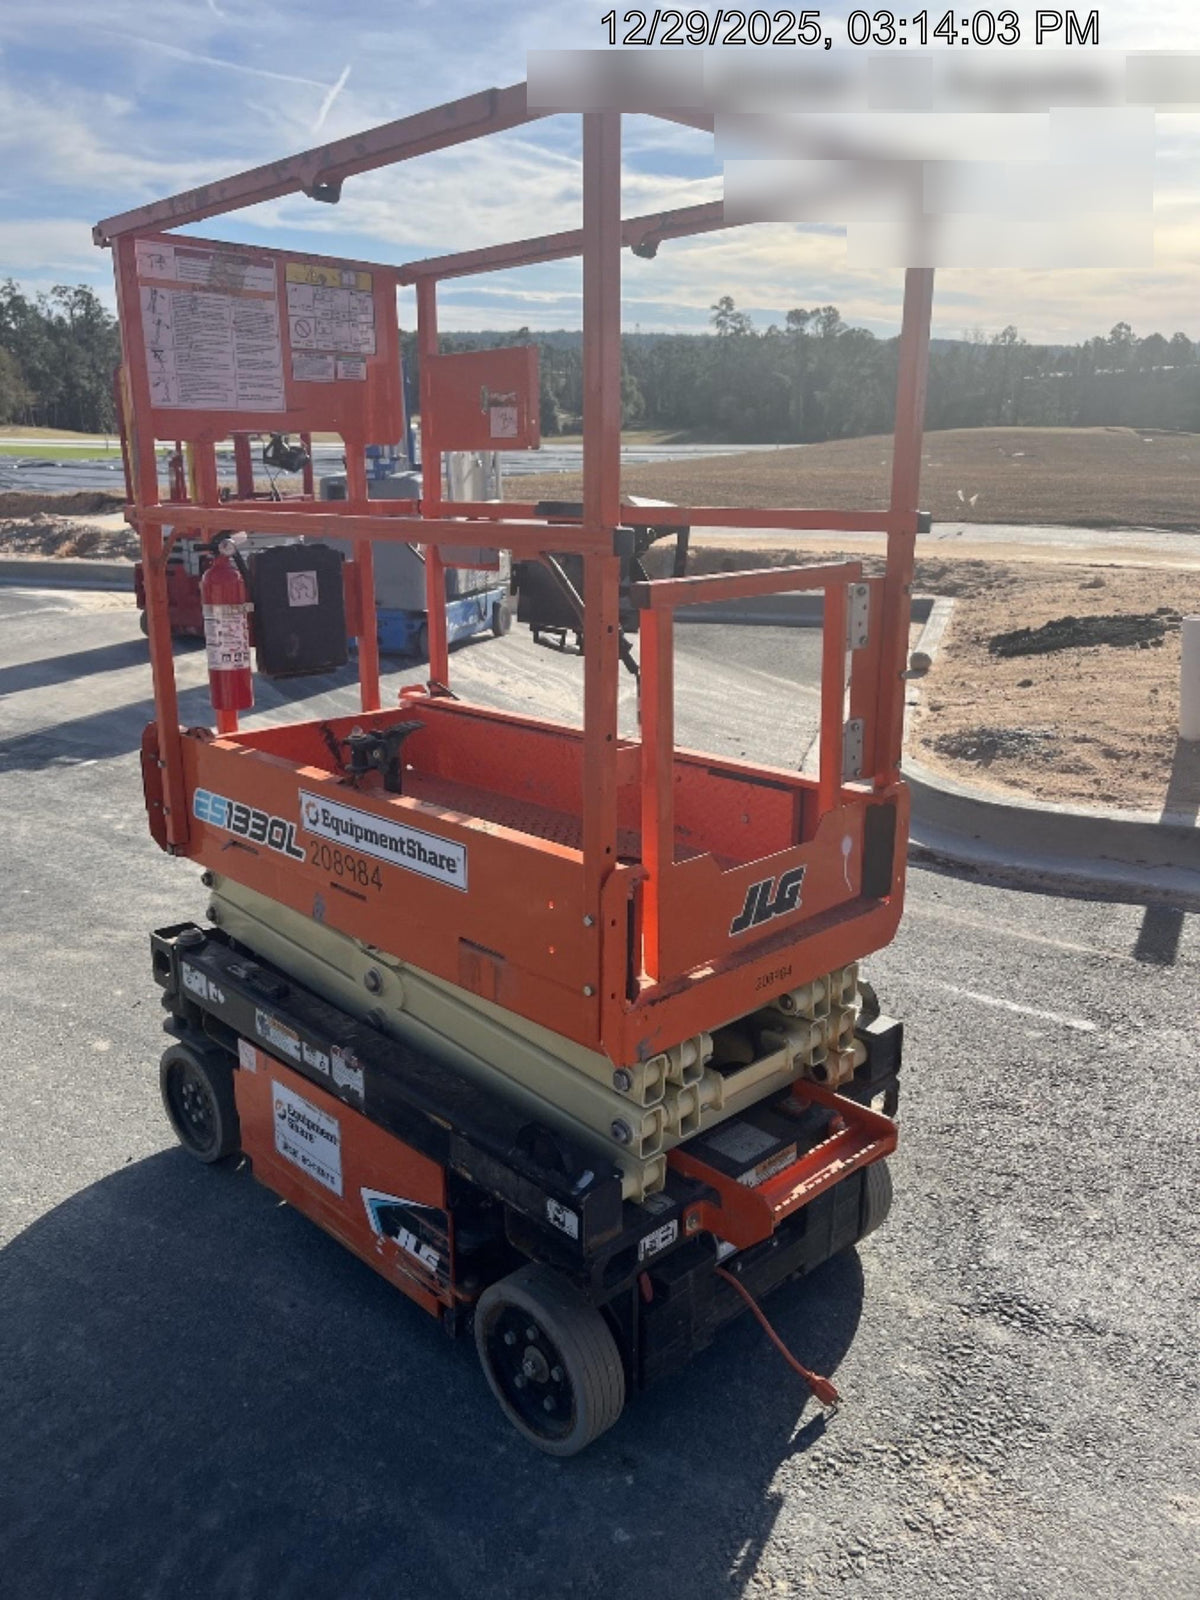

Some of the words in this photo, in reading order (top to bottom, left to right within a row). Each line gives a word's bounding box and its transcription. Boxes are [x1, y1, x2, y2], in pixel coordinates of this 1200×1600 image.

[194, 788, 305, 861] ES1330L
[321, 808, 458, 873] EquipmentShare
[311, 841, 383, 891] 208984
[730, 865, 806, 936] JLG
